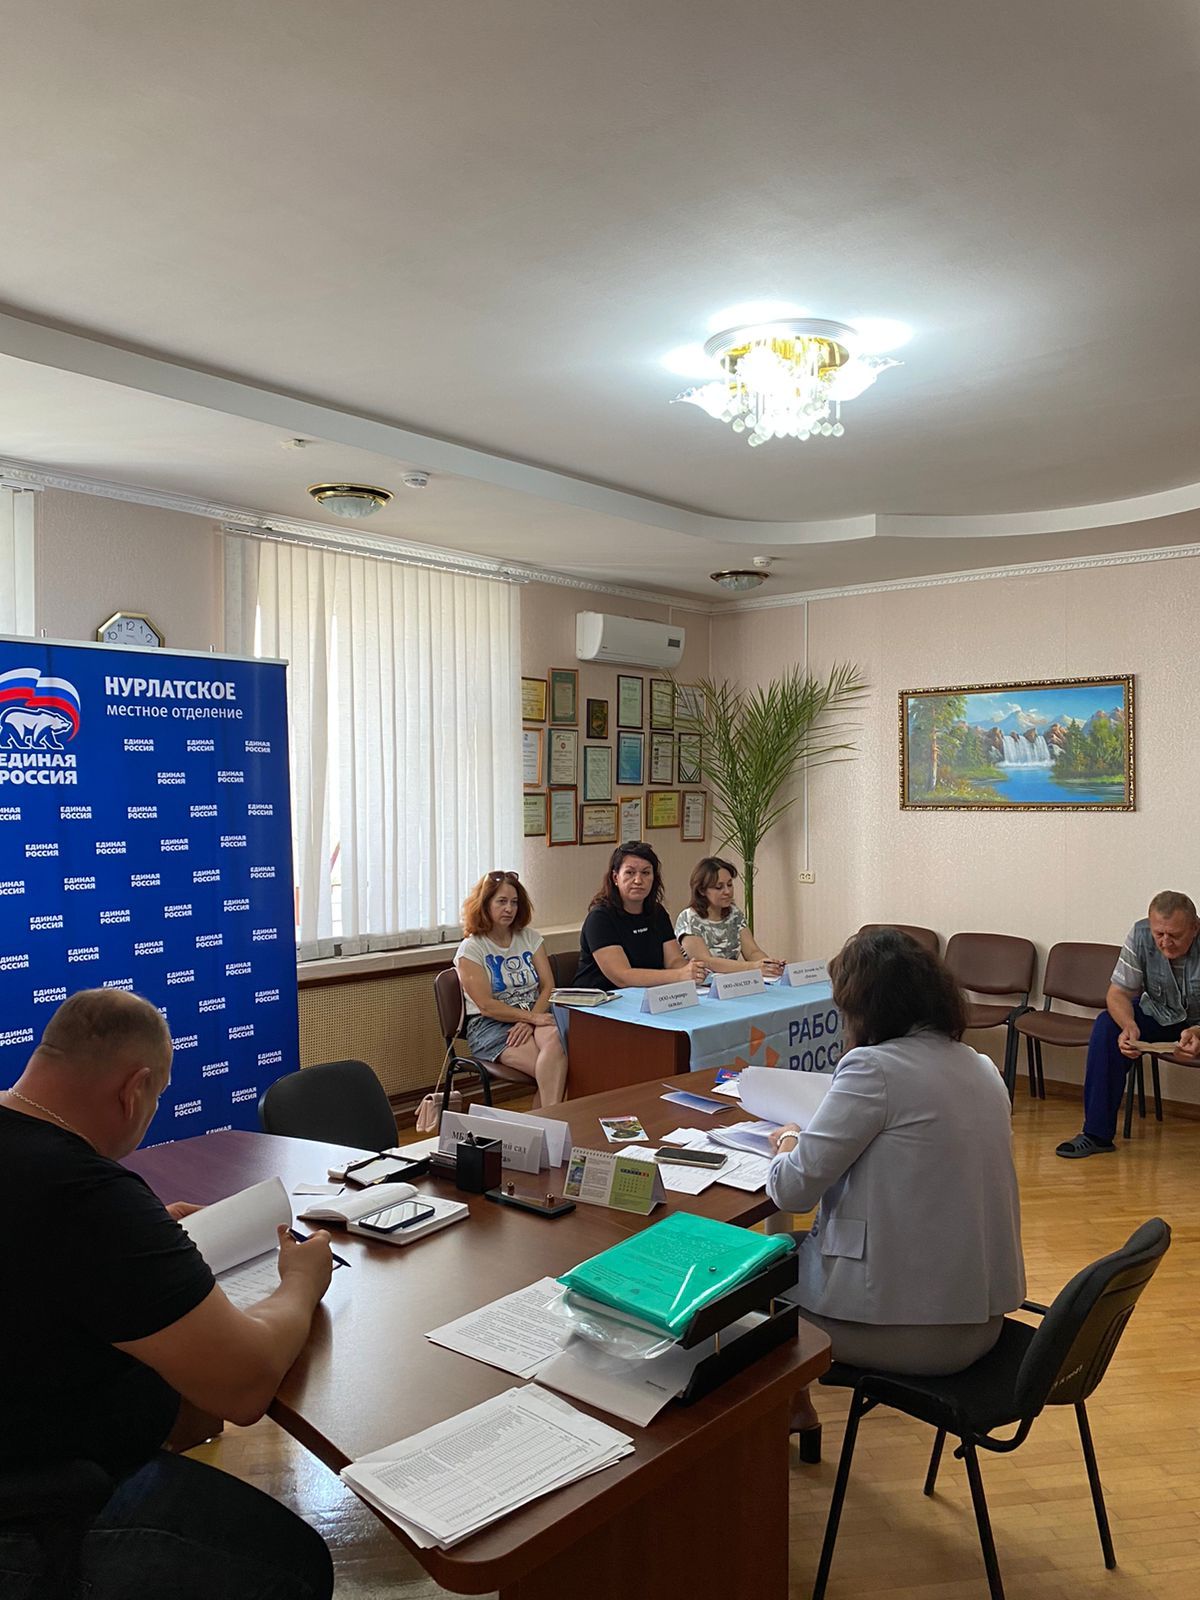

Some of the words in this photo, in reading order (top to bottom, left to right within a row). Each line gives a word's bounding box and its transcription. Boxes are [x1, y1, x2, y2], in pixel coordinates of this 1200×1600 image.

[117, 623, 123, 632] 11
[126, 620, 136, 631] 12
[107, 631, 118, 641] 10
[145, 633, 153, 643] 2
[104, 676, 236, 700] НУРЛАТСКОЕ
[106, 704, 168, 718] местное
[171, 706, 243, 720] отделение
[0, 753, 77, 768] ЕДИНАЯ
[0, 769, 78, 785] РОССИЯ
[190, 810, 218, 818] РОССИЯ
[25, 843, 58, 851] ЕДИНАЯ
[96, 847, 126, 855] РОССИЯ
[161, 844, 189, 852] РОССИЯ
[25, 850, 59, 858] РОССИЯ
[131, 873, 160, 881] ЕДИНАЯ
[193, 869, 220, 877] ЕДИНАЯ
[64, 876, 95, 884] ЕДИНАЯ
[131, 879, 160, 887] РОССИЯ
[193, 875, 220, 883] РОССИЯ
[64, 883, 96, 891] РОССИЯ
[164, 904, 192, 912] ЕДИНАЯ
[224, 904, 249, 912] РОССИЯ
[100, 909, 130, 918] ЕДИНАЯ
[164, 910, 192, 918] РОССИЯ
[30, 915, 63, 923] ЕДИНАЯ
[100, 916, 130, 924] РОССИЯ
[30, 921, 63, 930] РОССИЯ
[196, 933, 223, 942] ЕДИНАЯ
[134, 941, 163, 949] ЕДИНАЯ
[196, 939, 223, 948] РОССИЯ
[68, 947, 99, 955] ЕДИНАЯ
[135, 947, 164, 956] РОССИЯ
[68, 953, 99, 962] РОССИЯ
[226, 962, 251, 970] ЕДИНАЯ
[167, 970, 194, 978] ЕДИНАЯ
[226, 967, 251, 976] РОССИЯ
[167, 976, 194, 985] РОССИЯ
[33, 986, 67, 997] ЕДИНАЯ
[255, 989, 279, 997] ЕДИНАЯ
[33, 993, 67, 1004] РОССИЯ
[199, 997, 225, 1006] ЕДИНАЯ
[255, 995, 279, 1003] РОССИЯ
[199, 1003, 226, 1013] РОССИЯ
[228, 1024, 254, 1033] ЕДИНАЯ
[229, 1030, 254, 1040] РОССИЯ
[258, 1050, 281, 1059] ЕДИНАЯ
[789, 1040, 844, 1072] РОСС
[258, 1056, 282, 1066] РОССИЯ
[202, 1061, 228, 1071] ЕДИНАЯ
[203, 1067, 229, 1078] РОССИЯ
[232, 1087, 257, 1097] ЕДИНАЯ
[232, 1093, 257, 1103] РОССИЯ
[174, 1100, 201, 1111] ЕДИНАЯ
[175, 1106, 202, 1117] РОССИЯ
